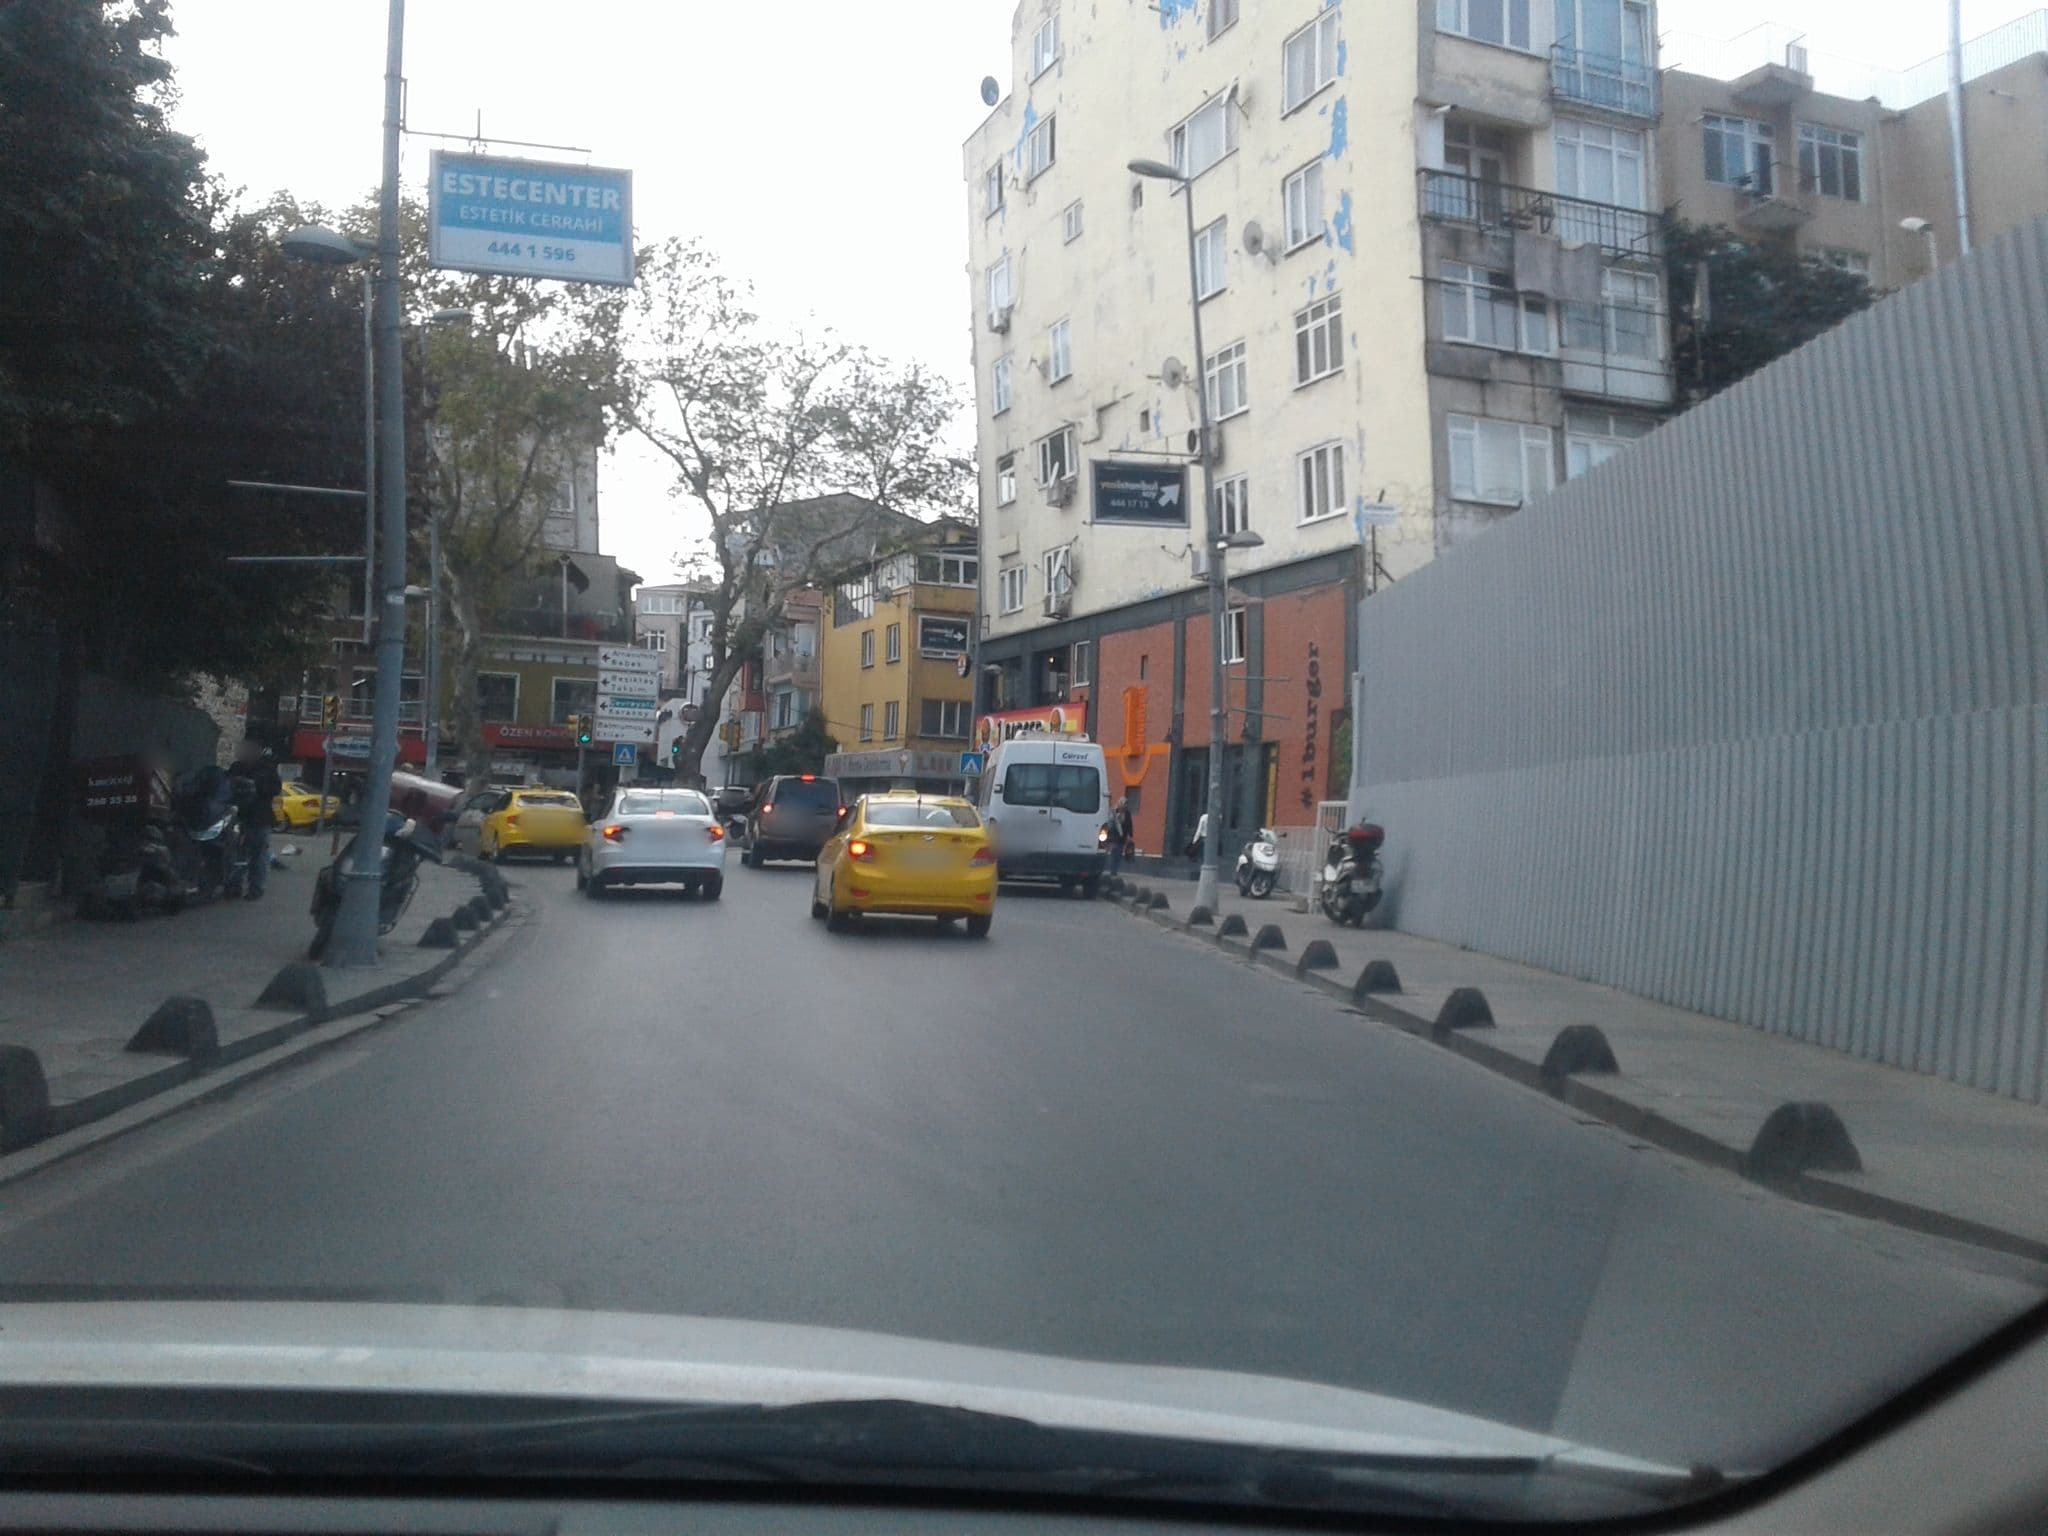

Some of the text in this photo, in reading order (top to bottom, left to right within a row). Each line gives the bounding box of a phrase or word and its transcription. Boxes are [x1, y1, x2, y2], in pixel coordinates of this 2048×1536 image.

[442, 172, 621, 210] ESTECENTER
[460, 205, 525, 225] ESTETİK
[488, 241, 576, 262] 444 1 596
